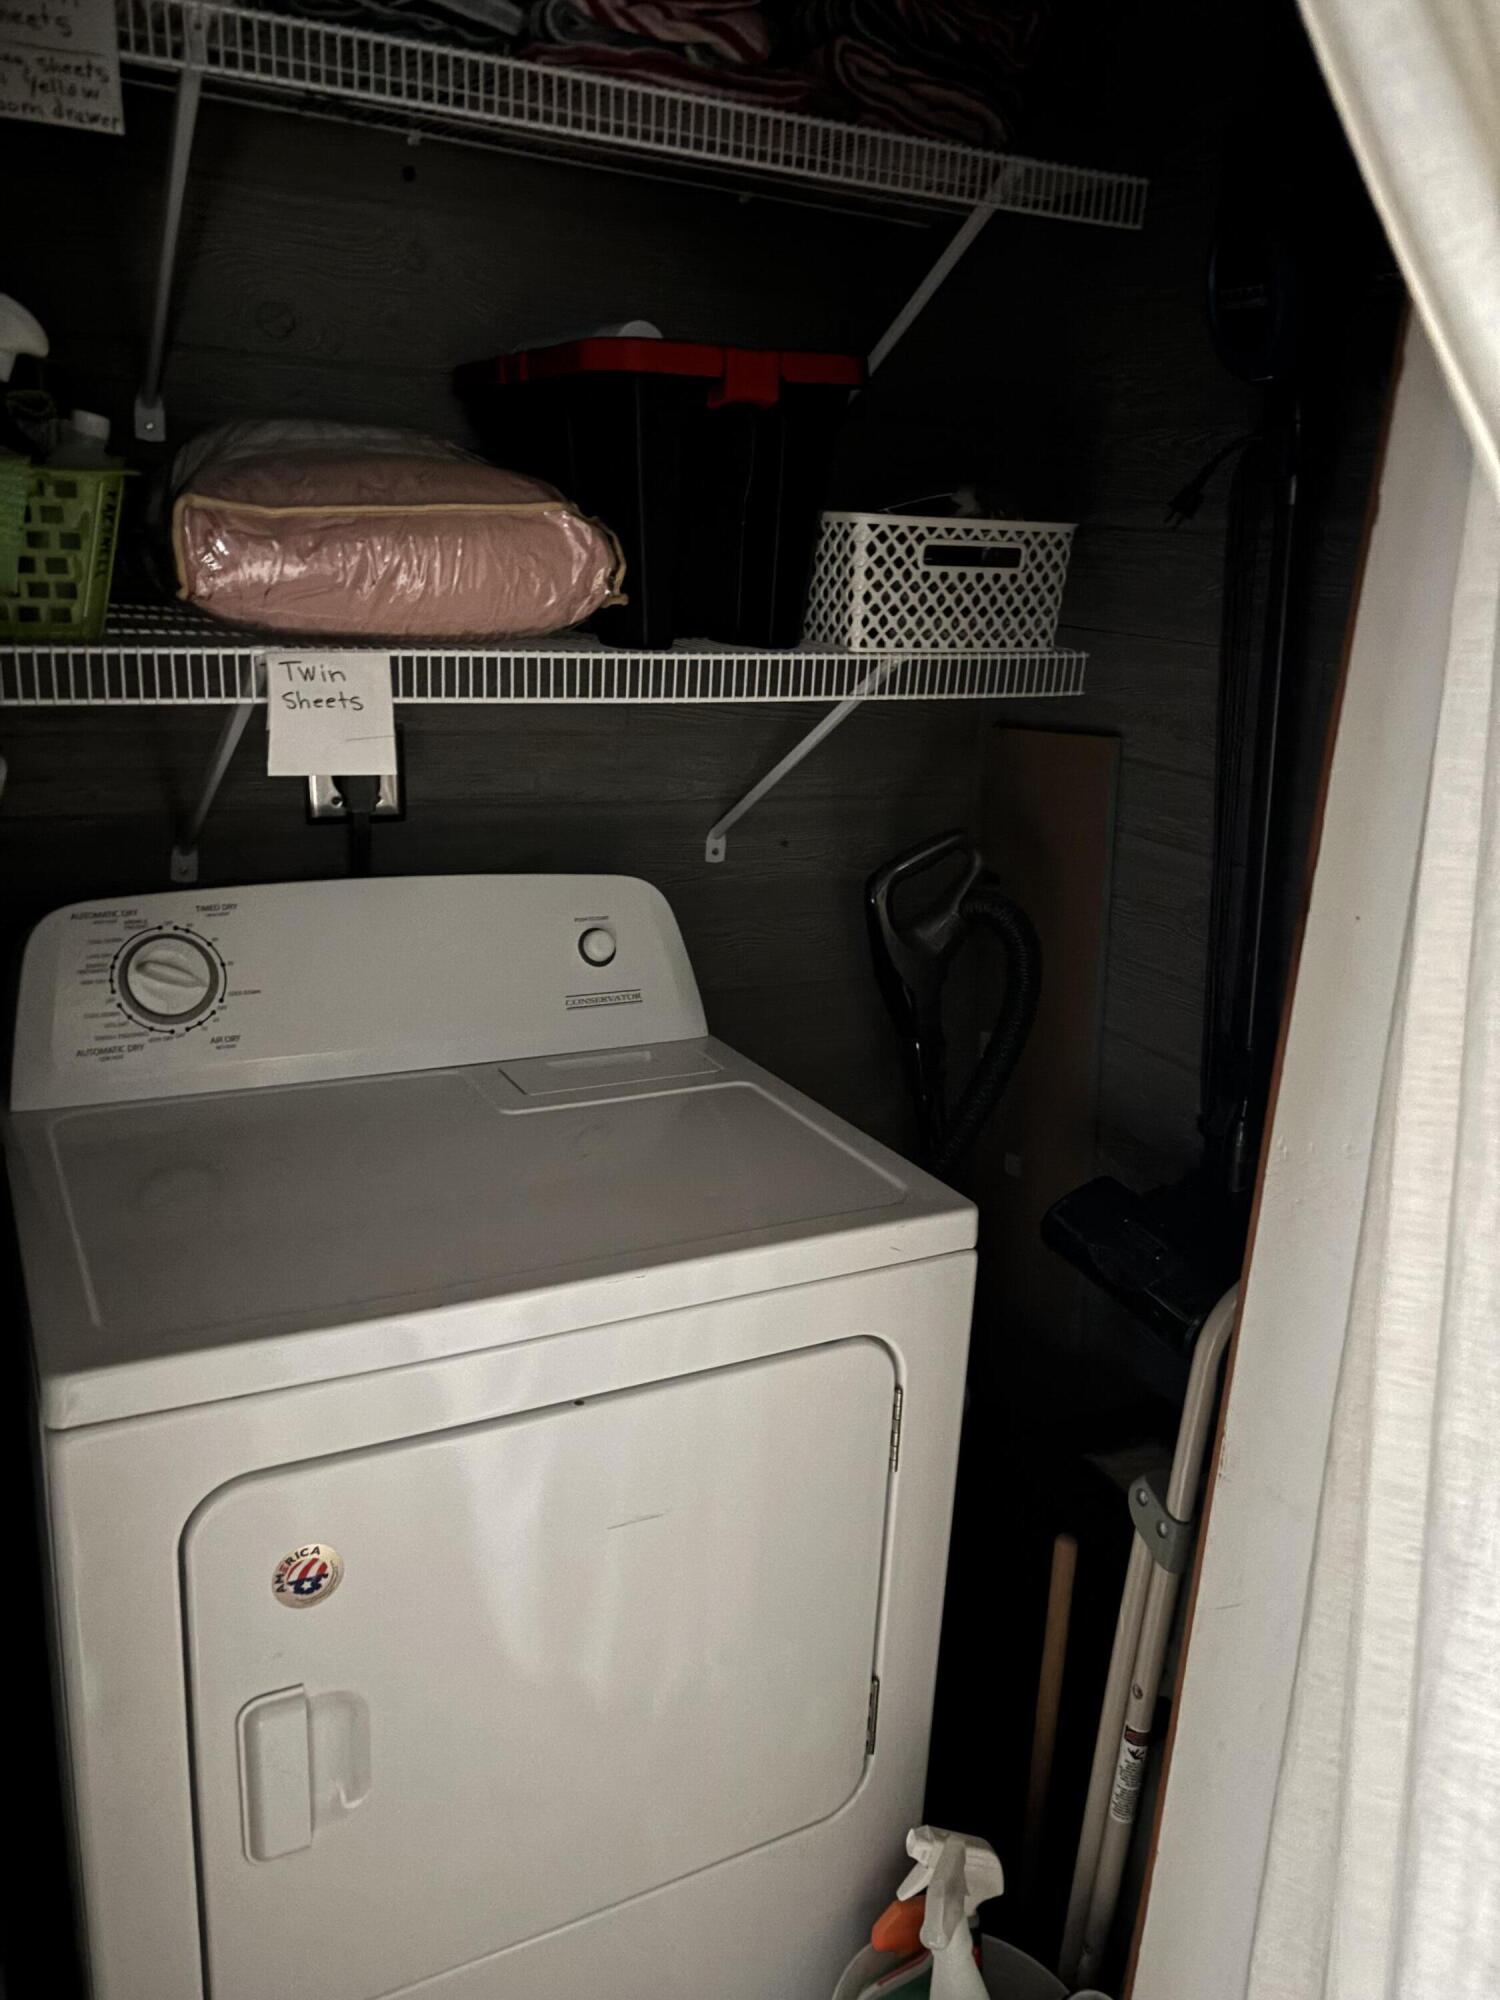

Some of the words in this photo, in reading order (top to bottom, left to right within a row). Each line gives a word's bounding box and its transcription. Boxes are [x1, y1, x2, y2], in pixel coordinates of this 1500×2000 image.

[278, 661, 346, 682] Twin
[282, 691, 364, 711] Sheets
[70, 910, 118, 920] AUTOMATIC
[120, 909, 138, 917] DRY
[565, 992, 641, 1006] CONSERVATOR
[210, 1036, 223, 1044] AIR
[224, 1035, 241, 1043] DRY
[76, 1045, 125, 1057] AUTOMATIC
[127, 1044, 145, 1052] DRY
[275, 1546, 320, 1593] AMERICA
